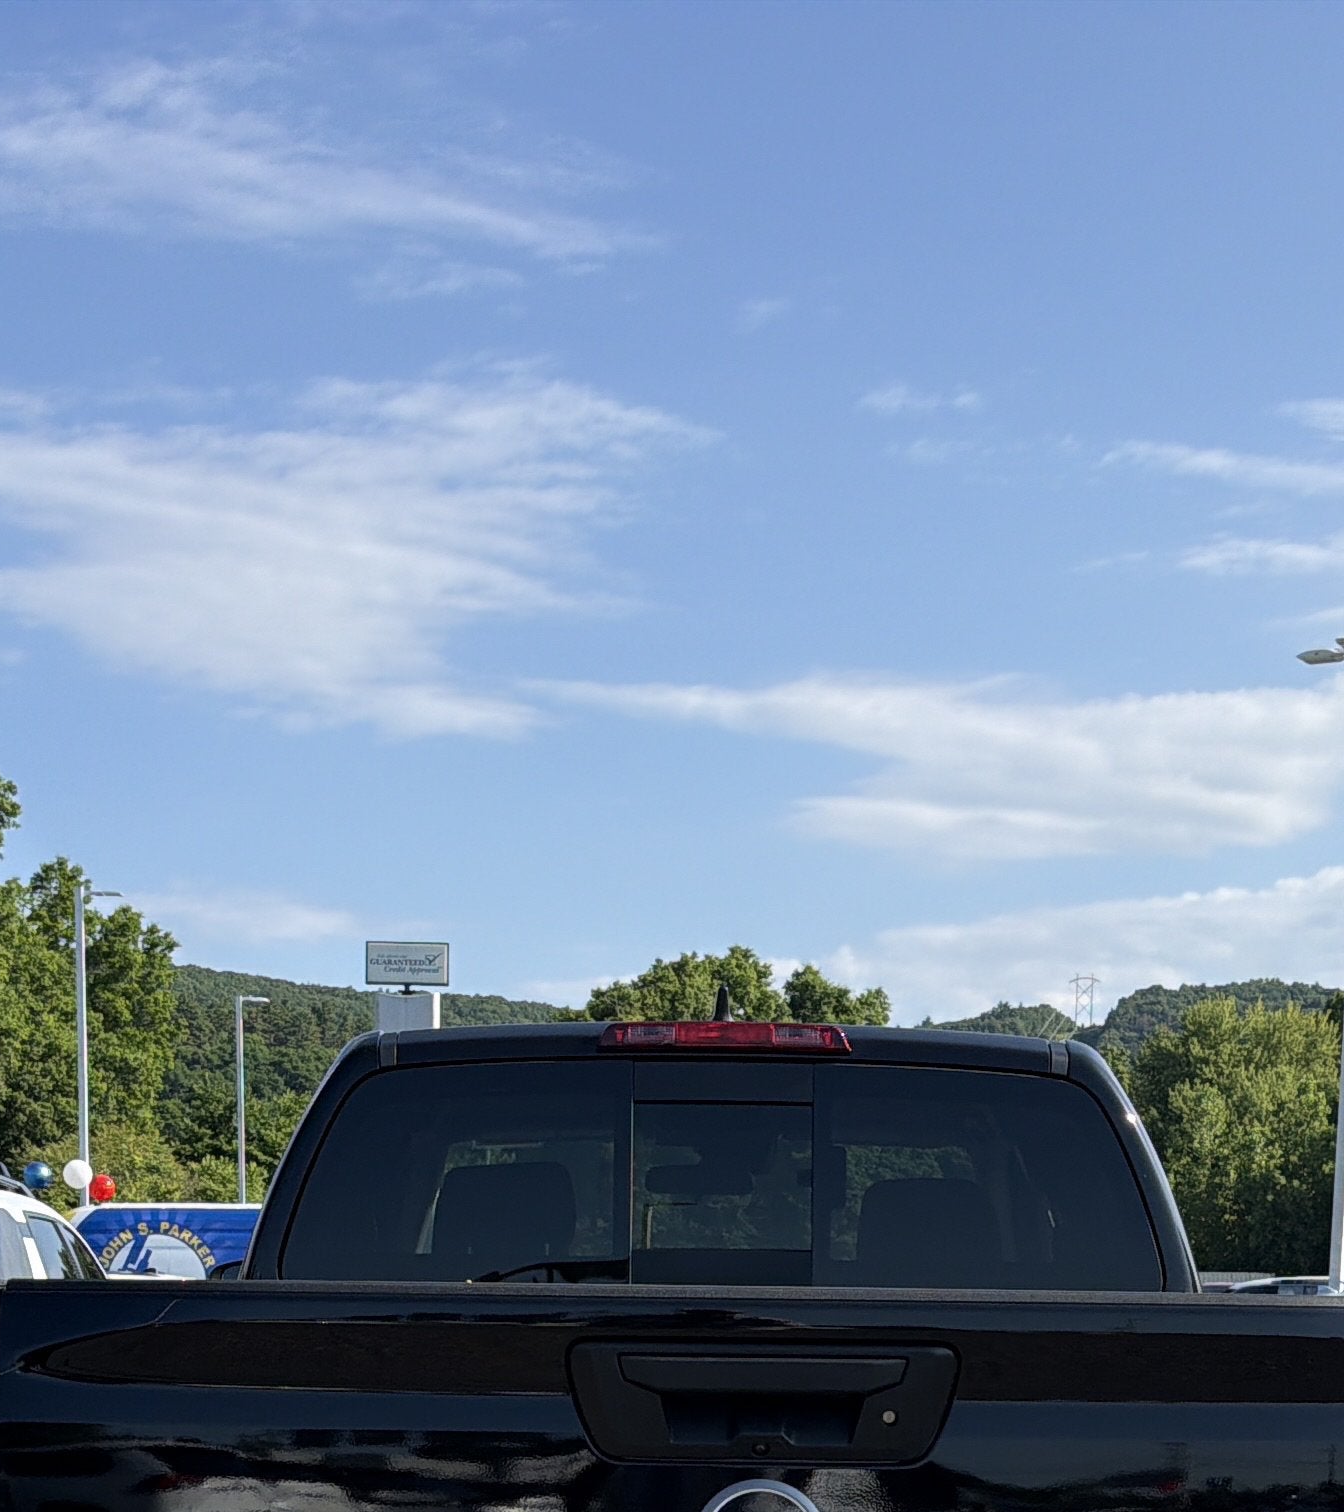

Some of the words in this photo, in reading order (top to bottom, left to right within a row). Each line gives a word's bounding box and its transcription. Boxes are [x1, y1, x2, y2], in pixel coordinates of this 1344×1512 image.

[369, 958, 425, 966] GUARANTEED
[98, 1229, 133, 1268] JOHN
[137, 1222, 154, 1235] S.
[160, 1221, 216, 1268] PARKER
